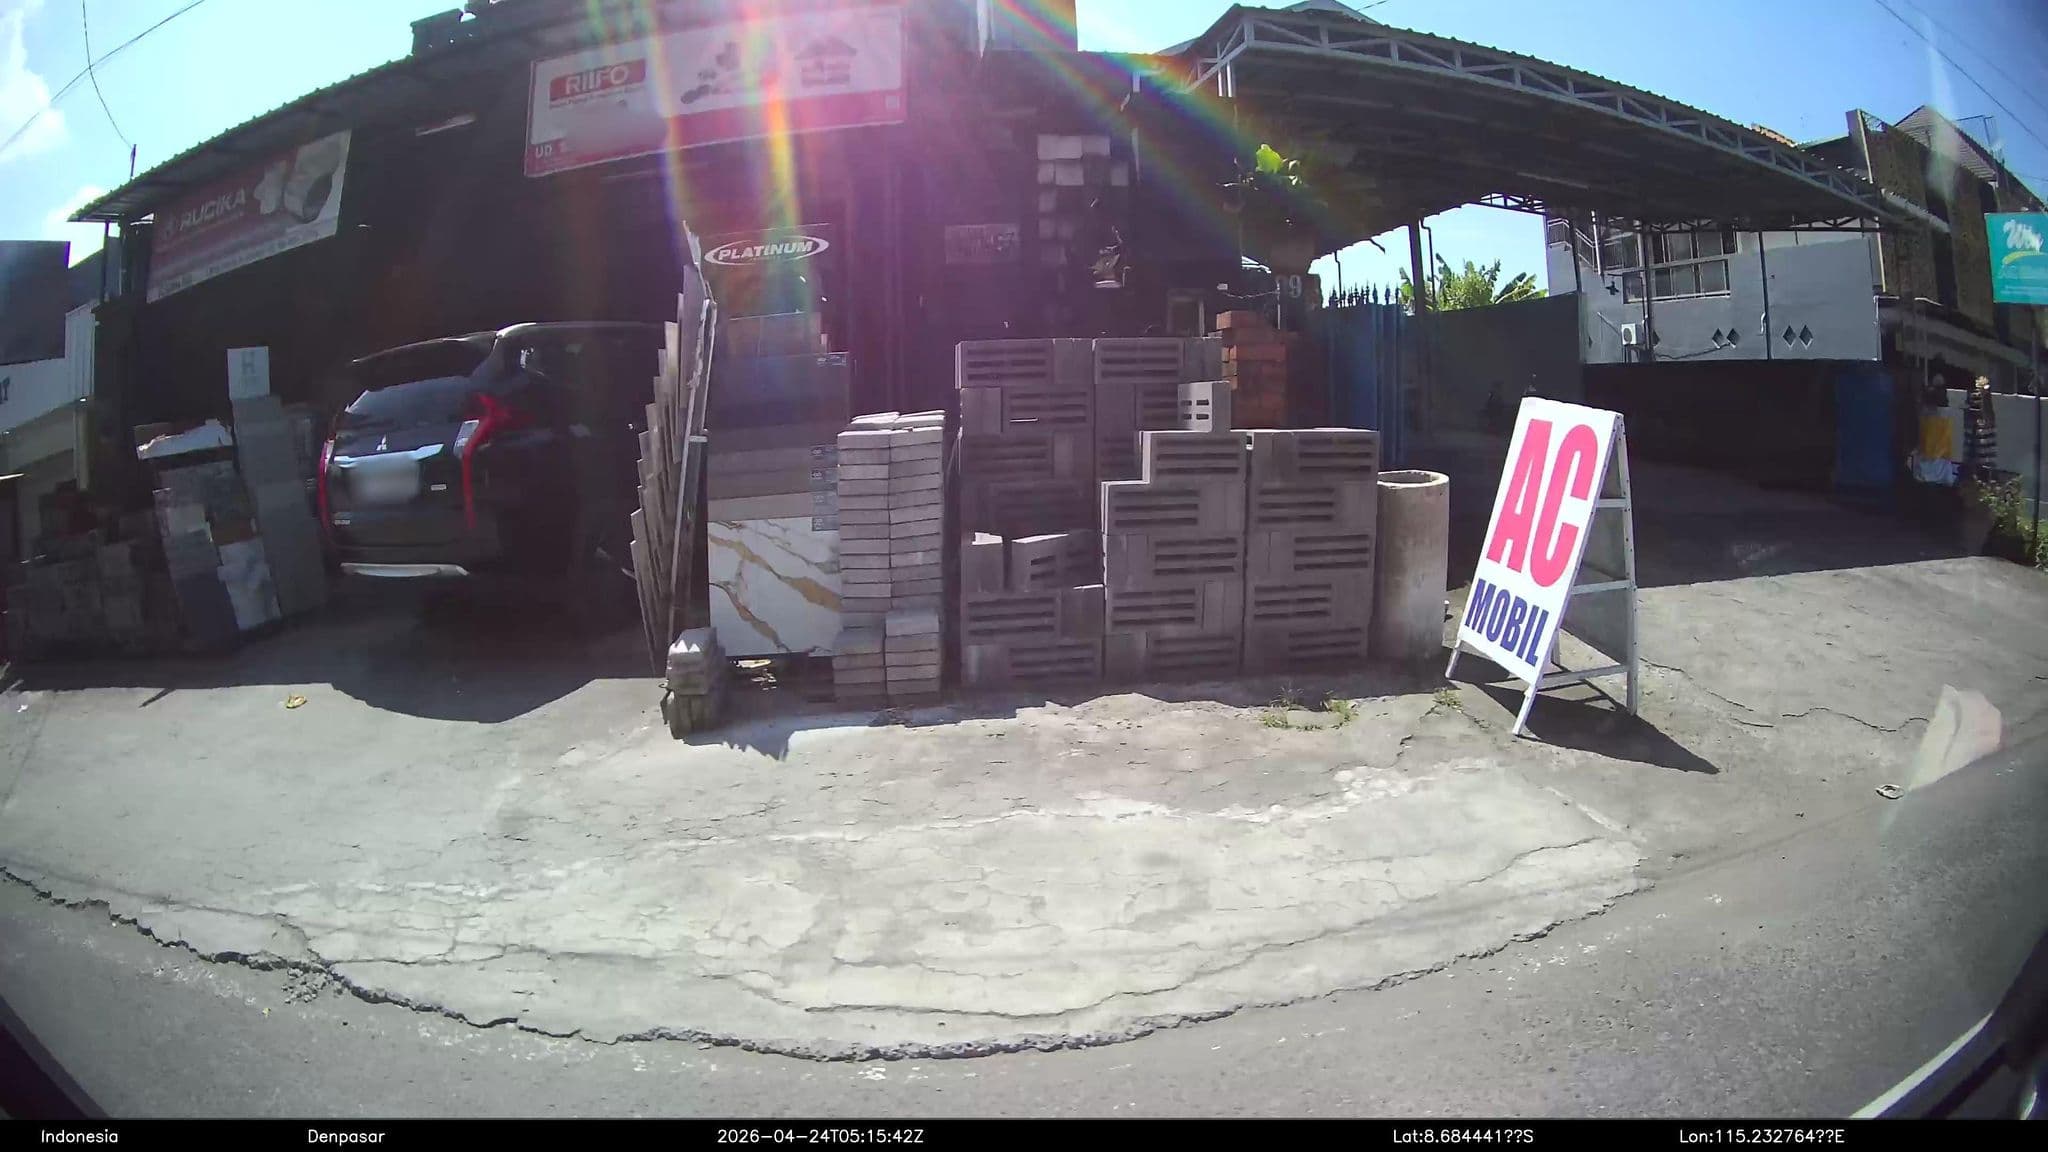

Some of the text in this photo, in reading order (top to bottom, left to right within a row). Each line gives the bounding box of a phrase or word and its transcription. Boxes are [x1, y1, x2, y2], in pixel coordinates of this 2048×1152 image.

[718, 240, 813, 261] PLATINUM
[1486, 418, 1598, 588] AC
[1465, 578, 1549, 668] MOBIL
